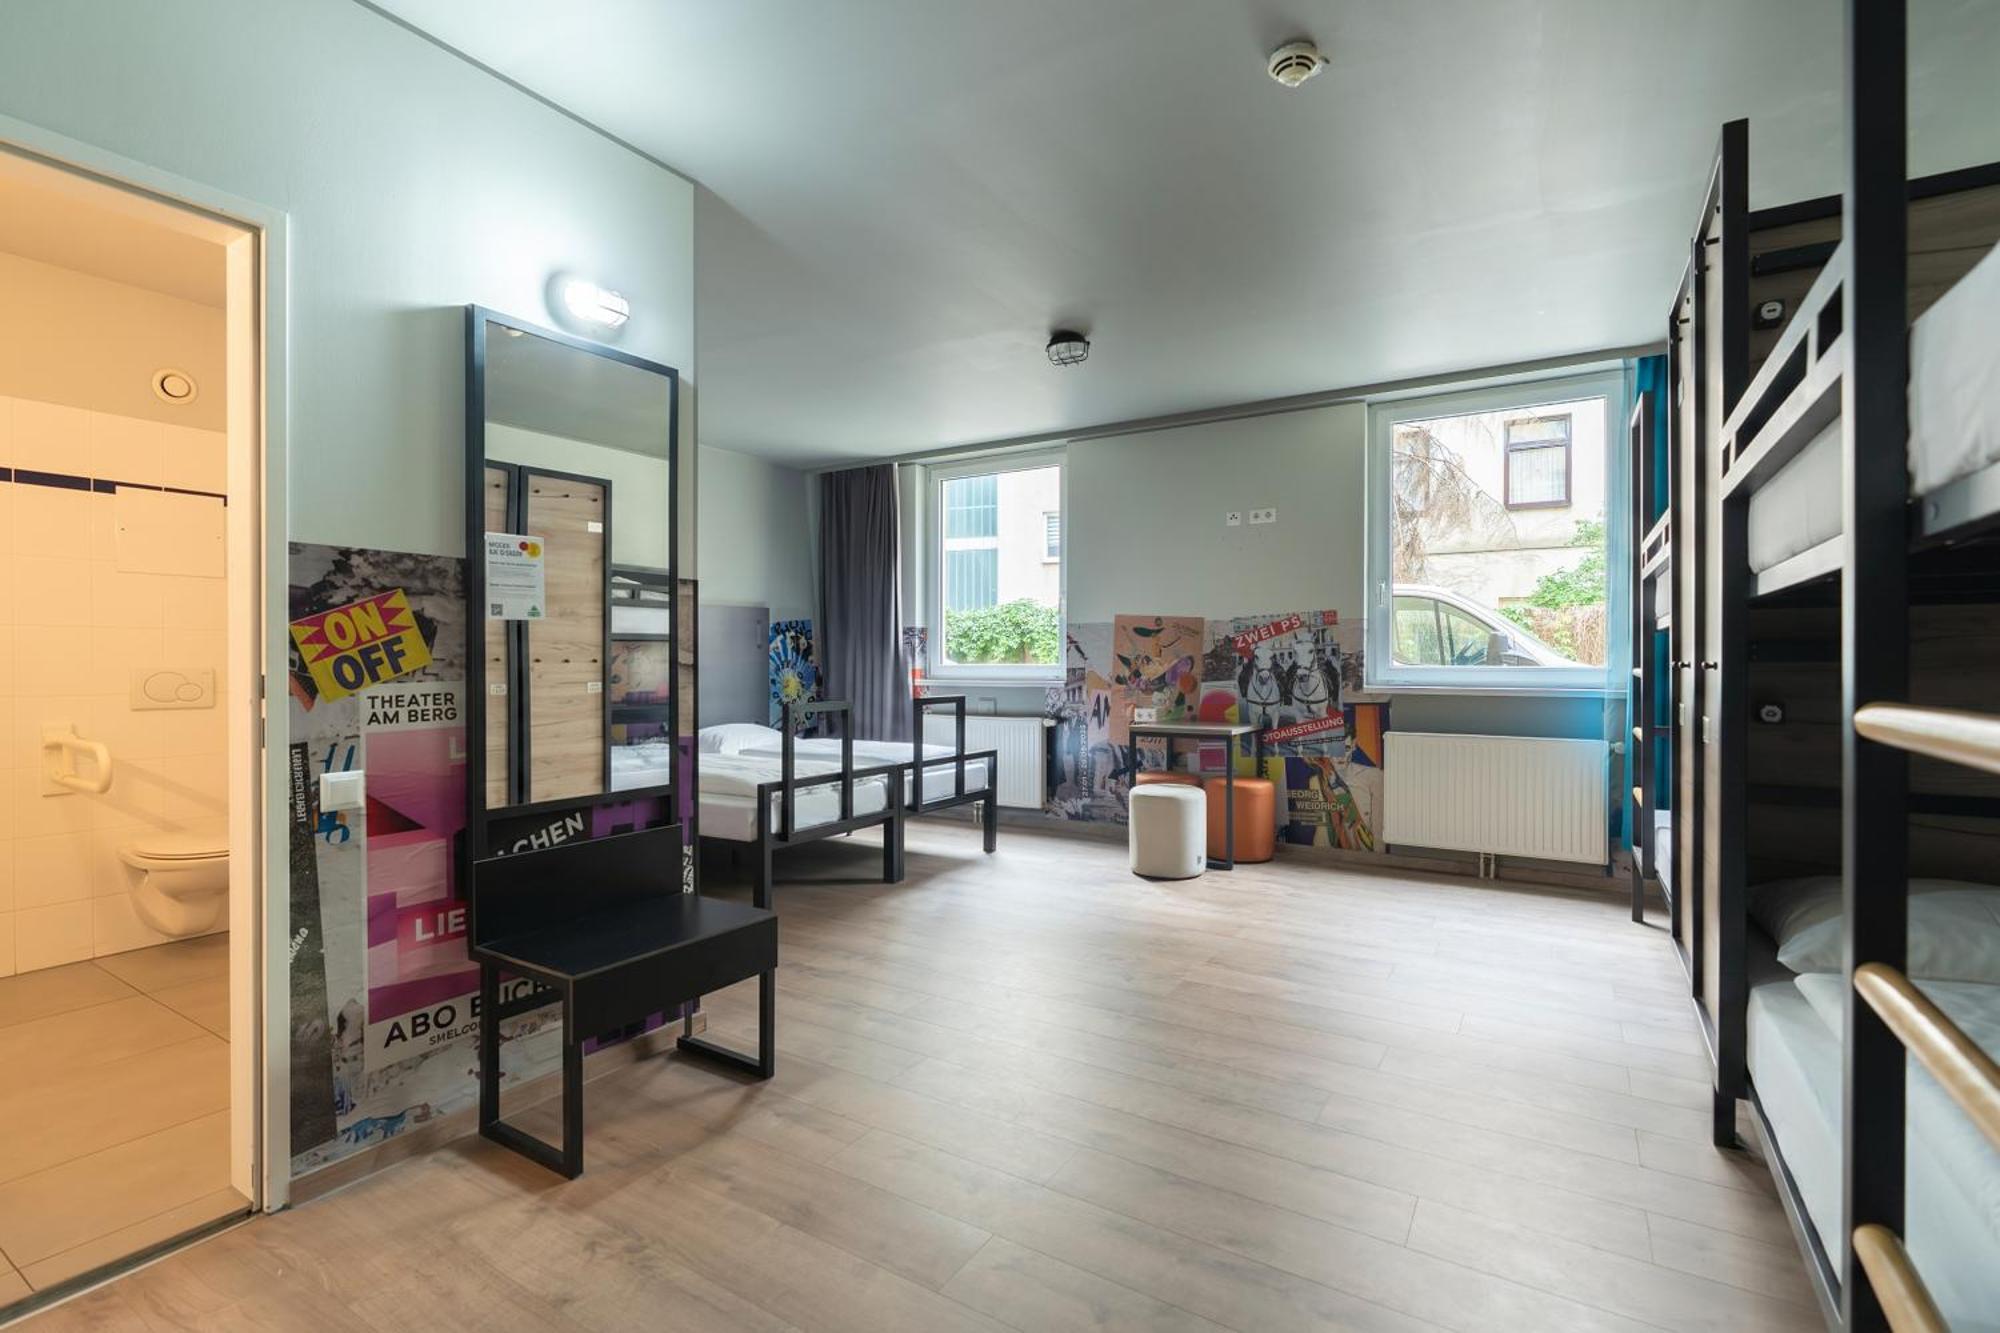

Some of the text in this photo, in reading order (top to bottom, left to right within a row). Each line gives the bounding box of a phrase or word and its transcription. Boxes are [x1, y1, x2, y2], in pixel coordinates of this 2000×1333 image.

[324, 601, 388, 650] ON
[1236, 625, 1276, 648] ZWEI
[1281, 616, 1301, 631] PS
[333, 636, 407, 691] OFF
[367, 692, 456, 711] THEATER
[367, 707, 458, 726] AM BERG
[1262, 717, 1344, 743] OTOAUSSTELLUNG
[497, 812, 586, 856] CHEN
[384, 1004, 456, 1048] ABO
